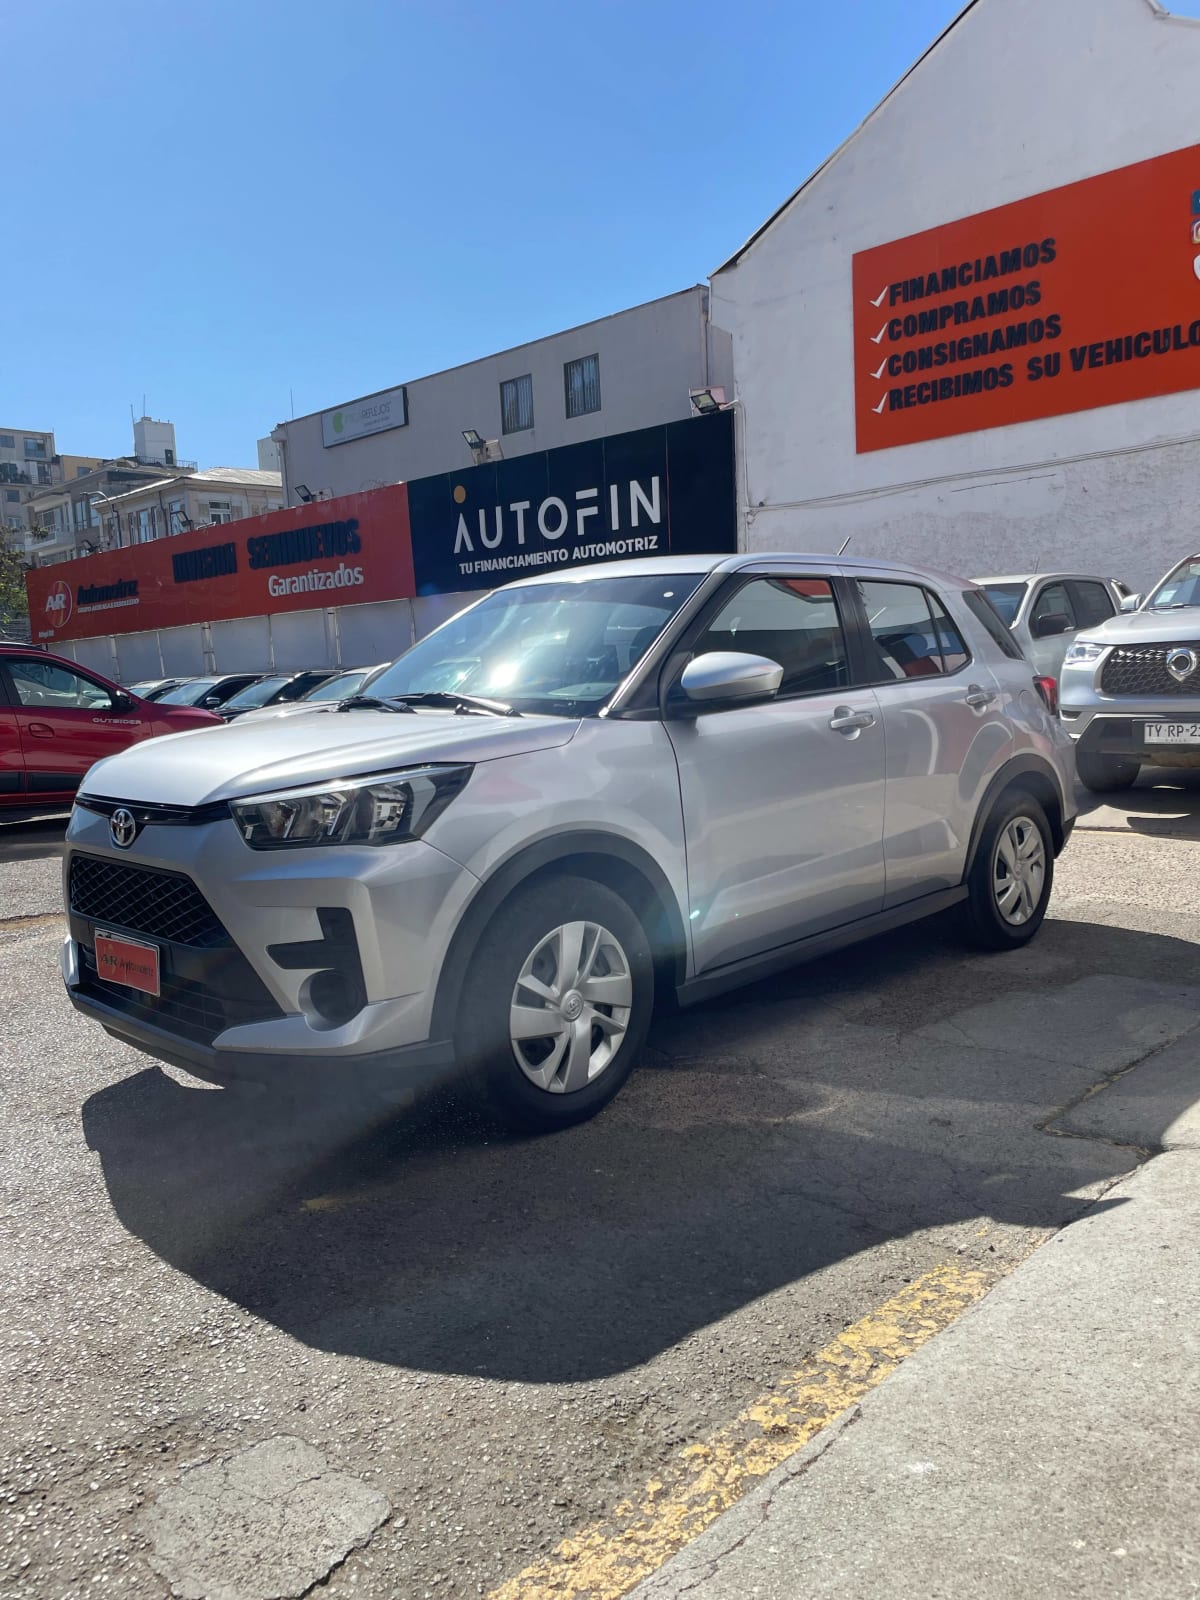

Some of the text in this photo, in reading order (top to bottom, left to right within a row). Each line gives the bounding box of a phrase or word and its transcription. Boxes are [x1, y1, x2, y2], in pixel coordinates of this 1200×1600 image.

[889, 237, 1056, 306] FINANCIAMOS
[887, 280, 1041, 341] COMPRAMOS
[887, 314, 1062, 376] CONSIGNAMOS
[889, 363, 1013, 411] RECIBIMOS
[1026, 352, 1061, 381] SU
[453, 475, 662, 554] AUTOFIN
[268, 562, 365, 598] Garantizados
[459, 535, 659, 575] TU FINANCIAMIENTO AUTOMOTRIZ
[92, 717, 142, 725] OUTSIDER
